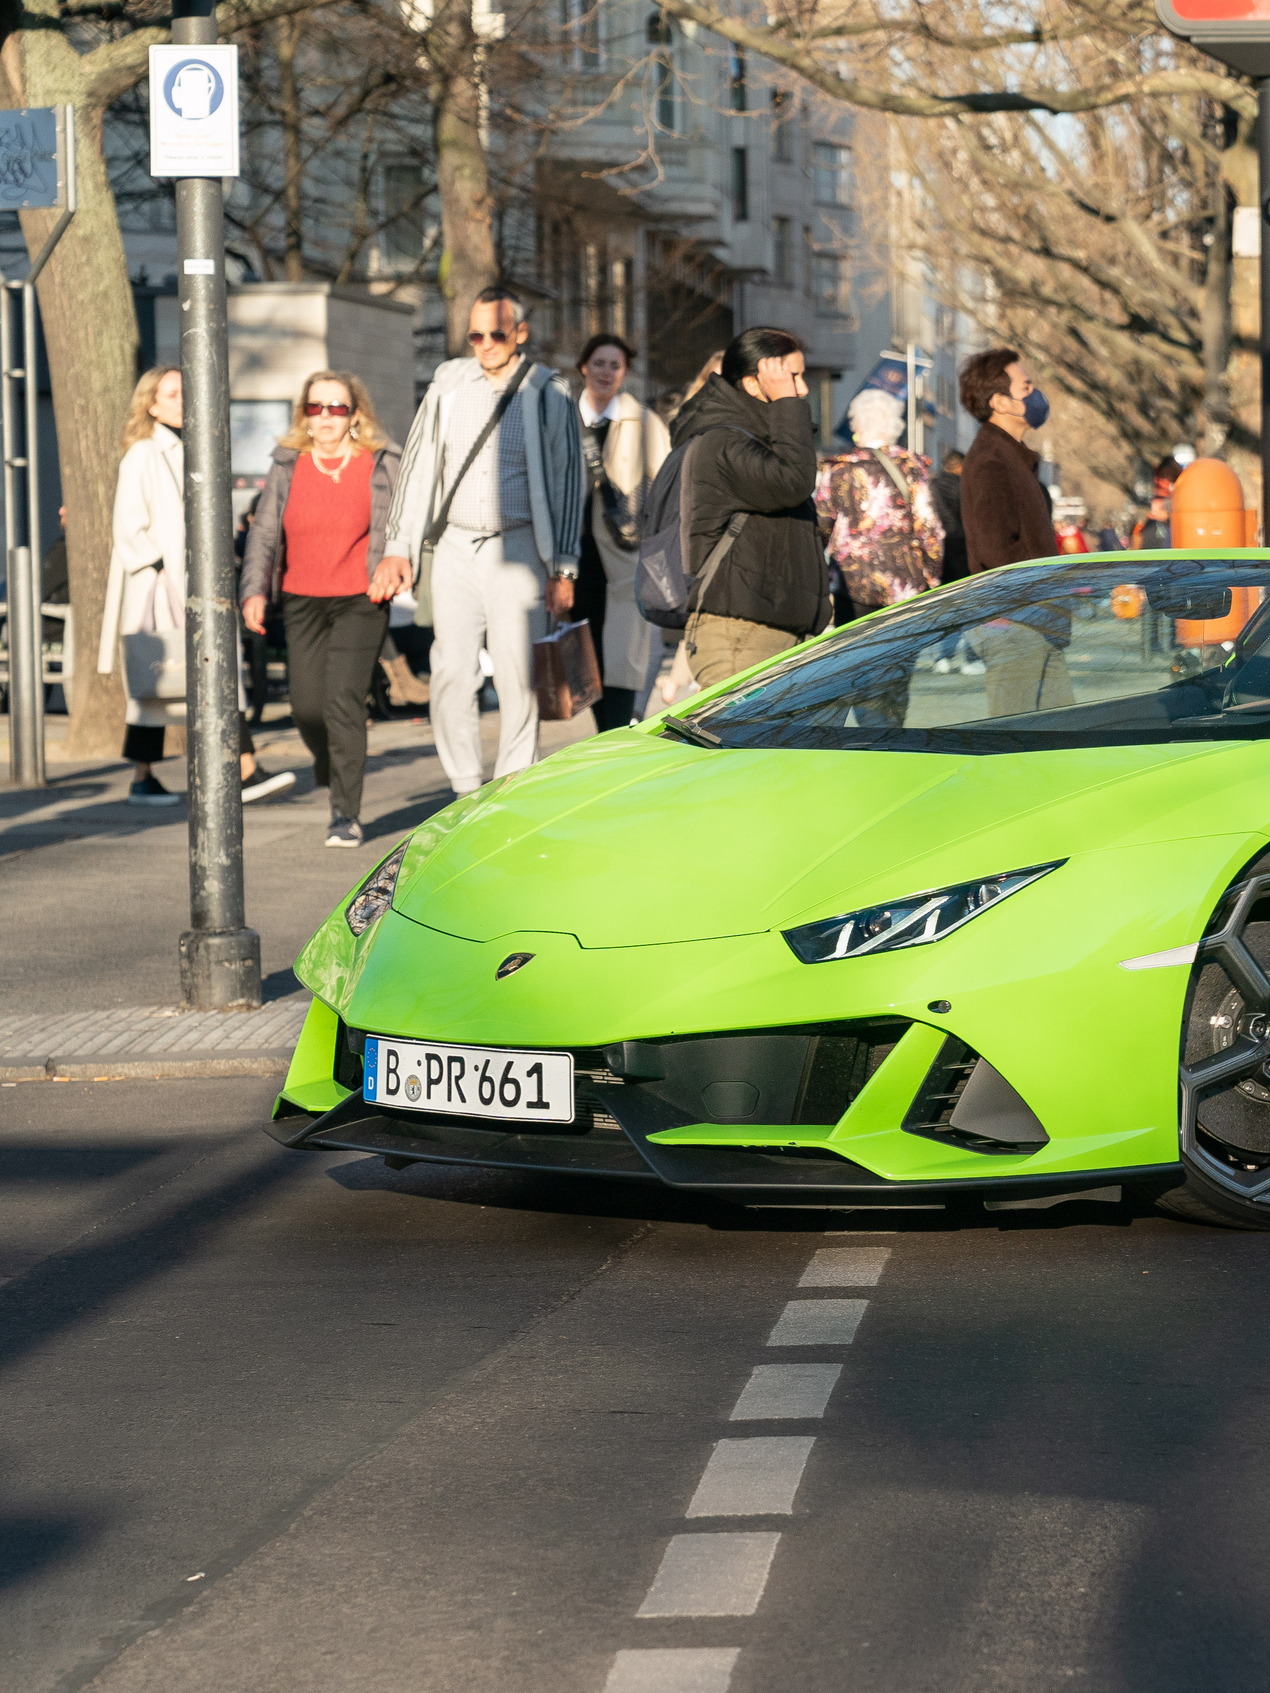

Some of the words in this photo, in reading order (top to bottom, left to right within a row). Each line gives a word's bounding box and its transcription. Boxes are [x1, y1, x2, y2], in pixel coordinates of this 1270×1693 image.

[368, 1076, 374, 1090] D
[386, 1048, 401, 1096] B
[425, 1052, 467, 1104] PR
[478, 1058, 551, 1110] 661
